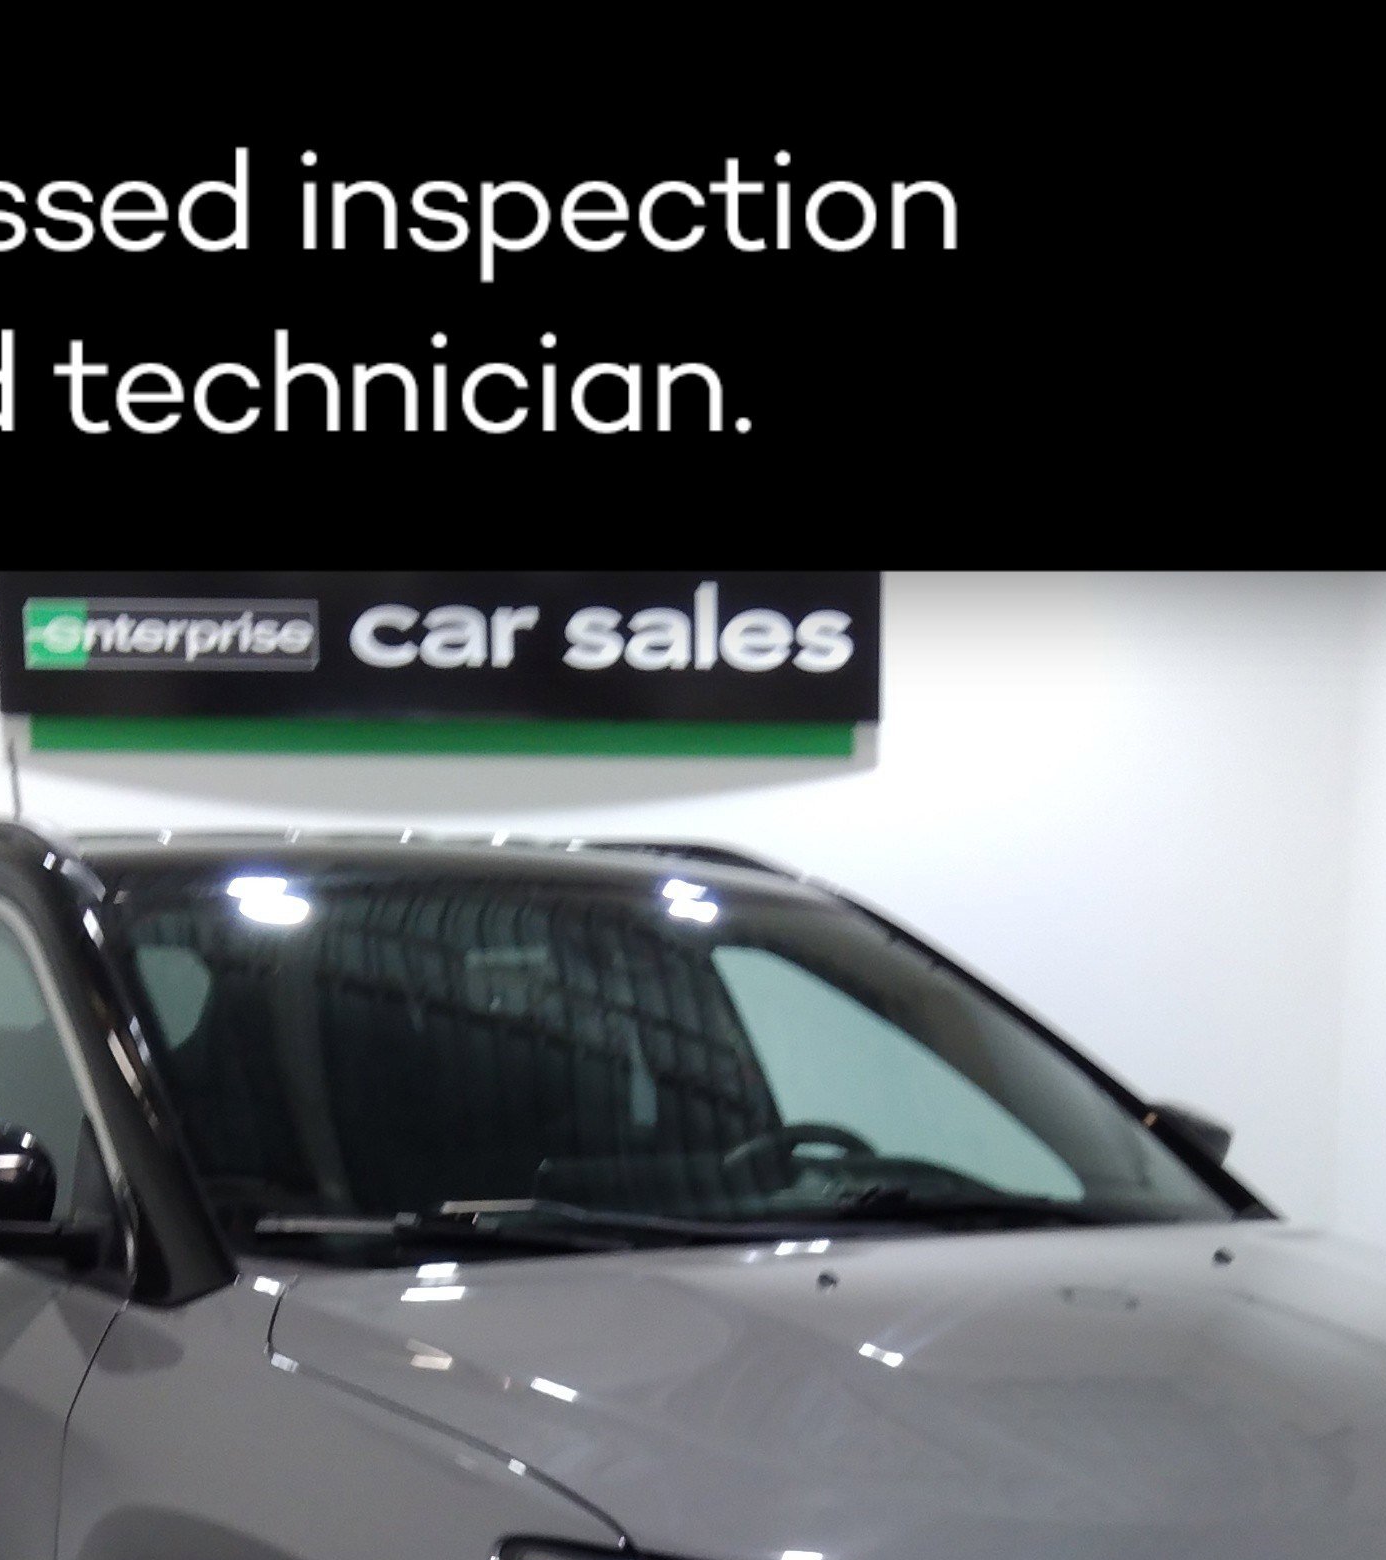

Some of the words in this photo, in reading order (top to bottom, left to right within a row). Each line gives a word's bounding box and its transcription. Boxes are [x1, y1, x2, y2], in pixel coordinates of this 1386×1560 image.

[29, 606, 315, 661] enterprise
[348, 602, 540, 669] car
[562, 580, 855, 673] sales
